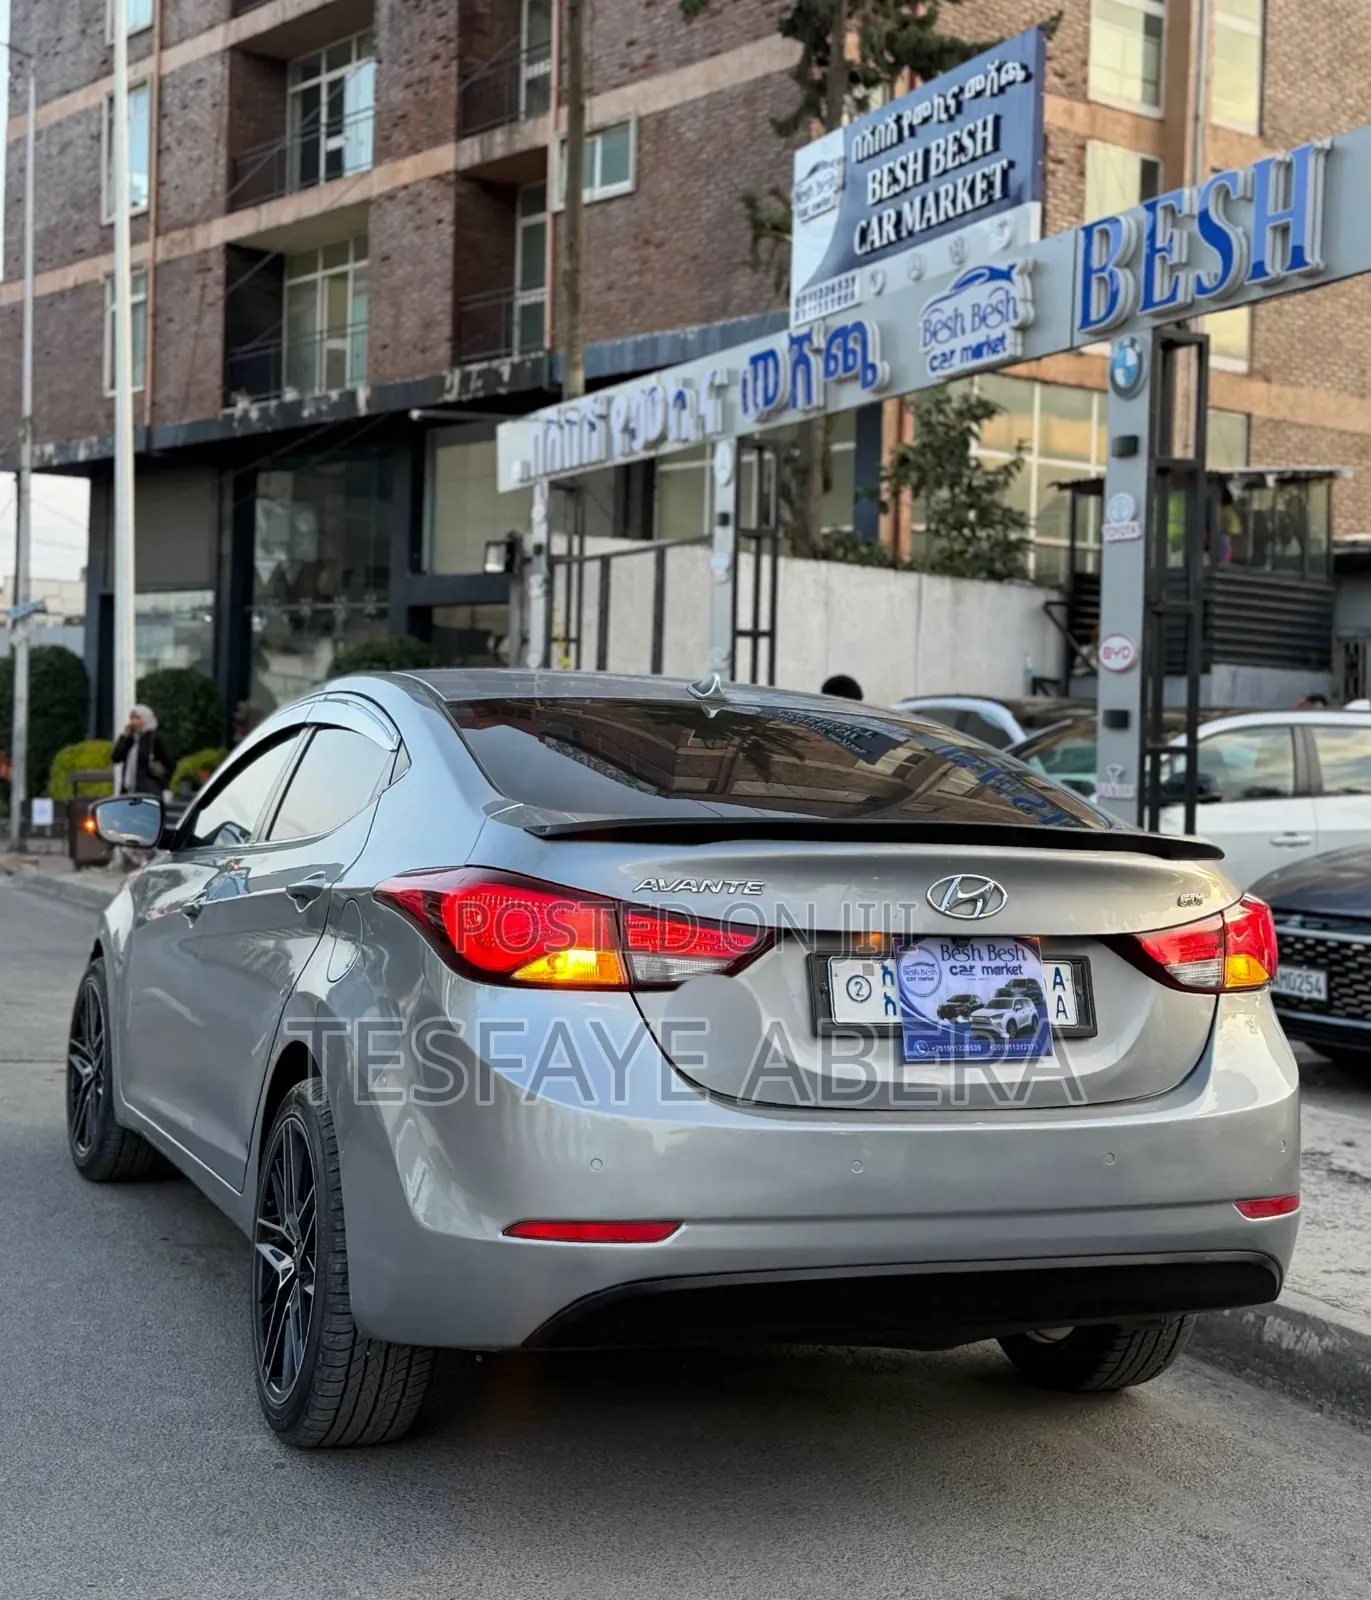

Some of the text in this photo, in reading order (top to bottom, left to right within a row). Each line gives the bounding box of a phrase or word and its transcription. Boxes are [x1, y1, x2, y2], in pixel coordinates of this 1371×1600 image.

[866, 112, 996, 206] BESH BESH
[853, 158, 1010, 256] CAR MARKET
[1077, 140, 1331, 333] BESH
[922, 286, 1019, 348] Besh Besh
[928, 331, 1007, 372] car market
[1102, 645, 1131, 660] BYD
[632, 877, 765, 896] AVANTE
[940, 943, 1028, 963] Besh Besh
[949, 963, 1024, 976] car market
[1052, 966, 1067, 992] A
[854, 980, 865, 998] 2
[1055, 994, 1069, 1020] A
